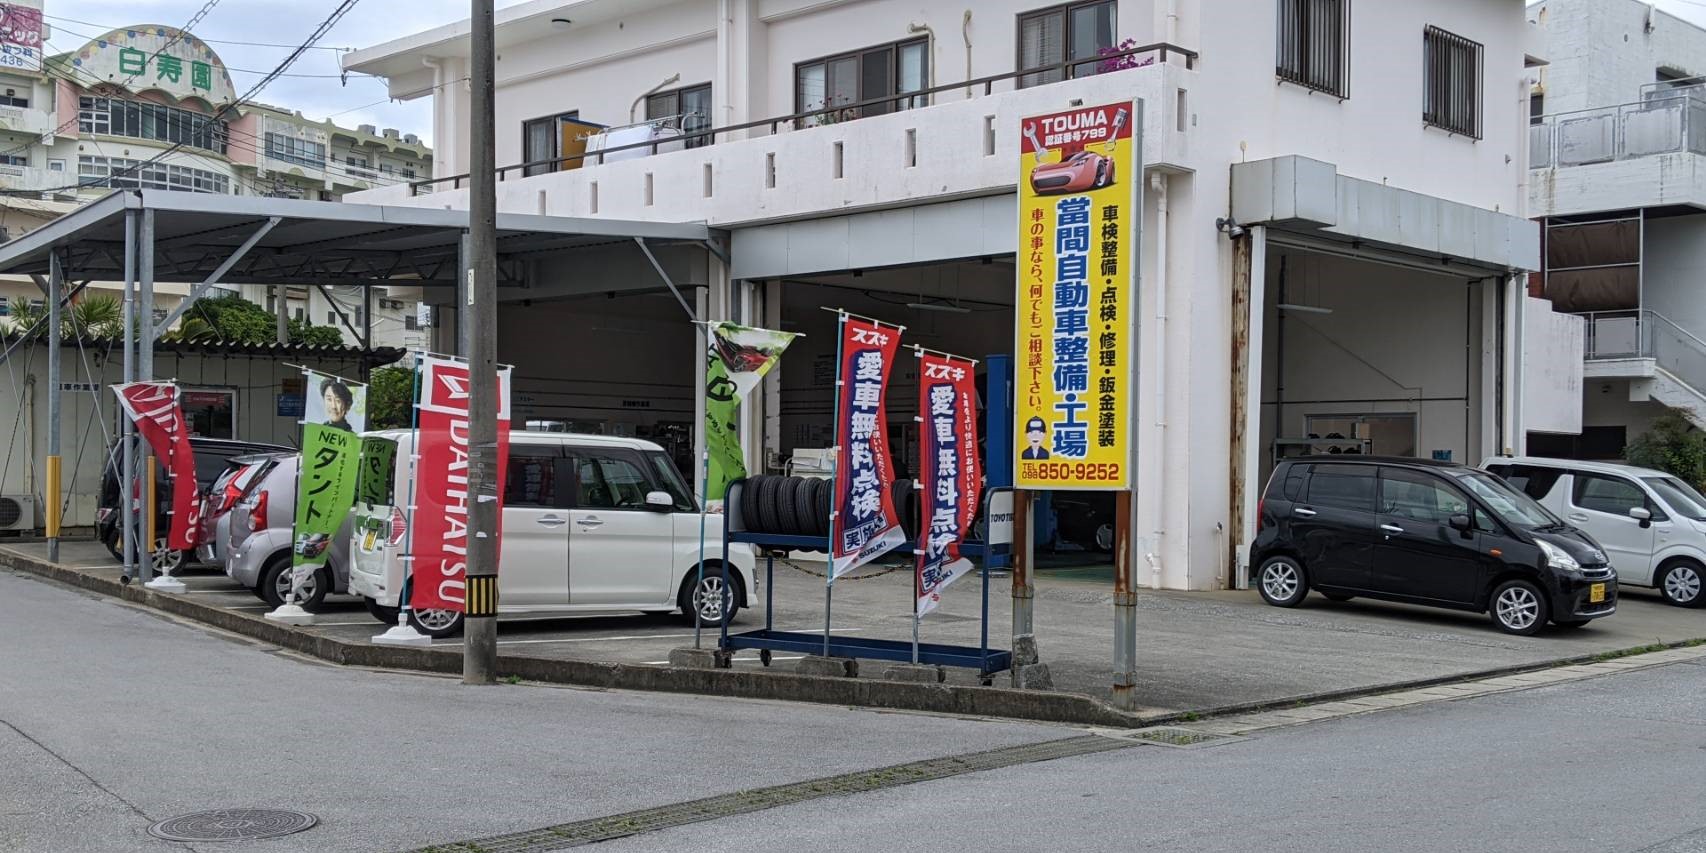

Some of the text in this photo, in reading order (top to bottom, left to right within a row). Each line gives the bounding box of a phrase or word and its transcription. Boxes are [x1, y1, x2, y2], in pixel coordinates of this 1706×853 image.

[119, 46, 211, 91] 白寿園
[1041, 109, 1108, 134] TOUMA
[1028, 208, 1044, 411] 車の事なら、何でもご相談下さい。
[850, 327, 889, 347] スズキ
[1098, 205, 1119, 447] 車検整備・点検・修理・鈑金塗装
[924, 362, 966, 381] スズキ
[318, 430, 348, 447] NEW
[851, 352, 882, 521] 愛車無料点検
[925, 385, 958, 560] 愛車無料点検
[1022, 463, 1037, 471] TEL
[1022, 463, 1119, 480] 098 850-9252
[306, 447, 339, 524] タント
[990, 513, 1005, 523] TOYO
[859, 540, 887, 558] SUZUKI
